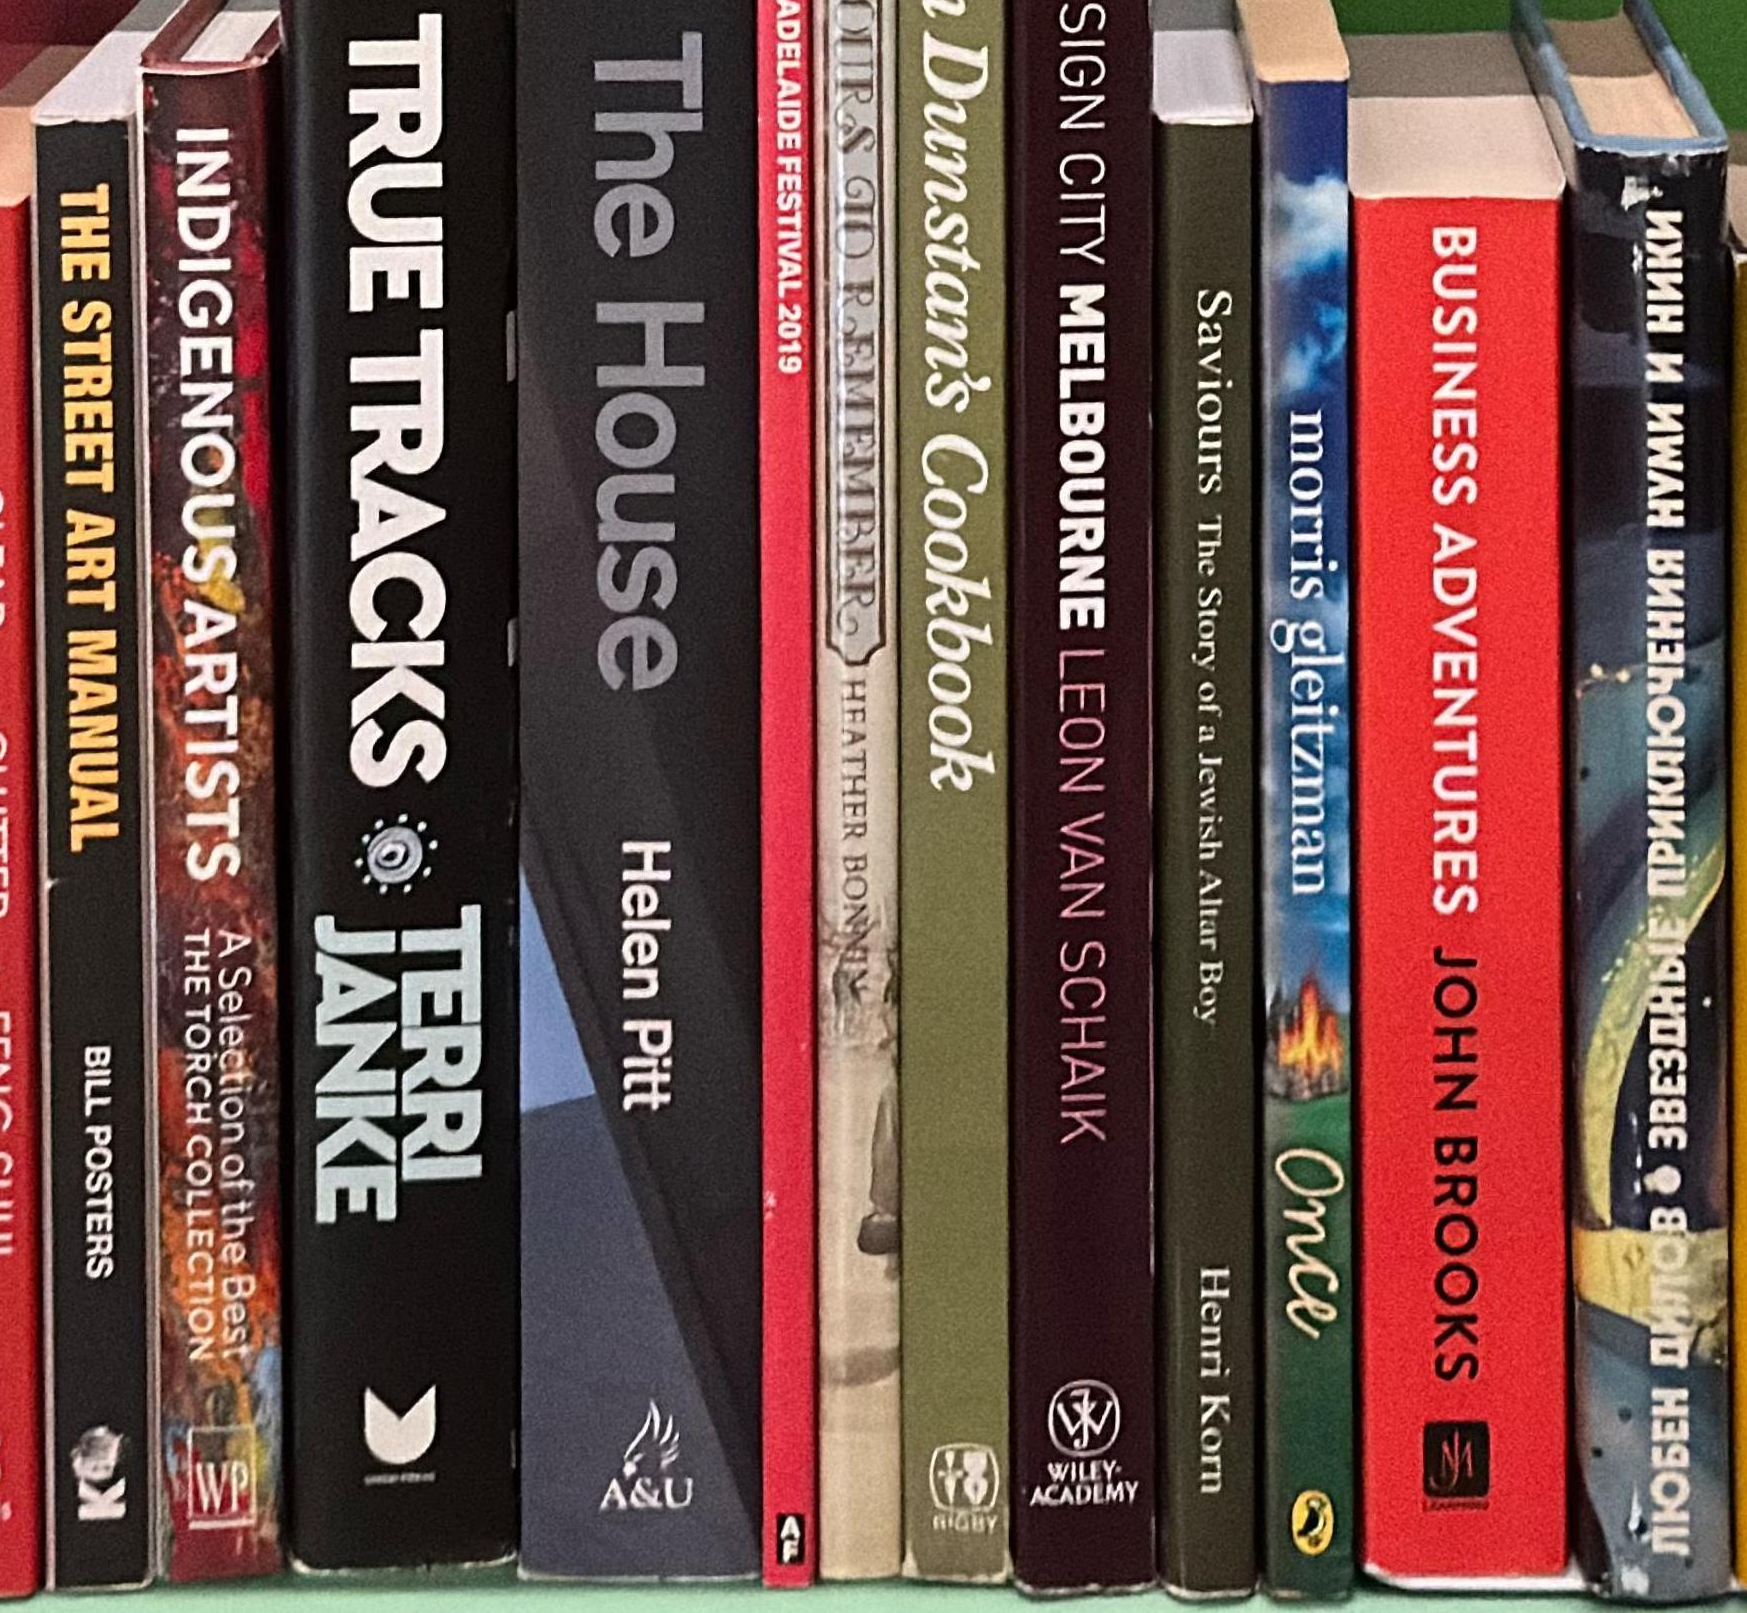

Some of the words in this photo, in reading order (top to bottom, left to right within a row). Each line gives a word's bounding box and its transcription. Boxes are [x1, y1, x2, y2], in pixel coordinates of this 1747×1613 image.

[347, 12, 444, 312] TRUE
[593, 31, 704, 258] The
[1059, 153, 1106, 266] CITY
[60, 183, 110, 282] THE
[777, 158, 802, 297] FESTIVAL
[922, 31, 992, 414] Dunstan's
[1646, 209, 1684, 333] НИКИ
[62, 300, 115, 494] STREET
[176, 127, 237, 584] INDIGENOUS
[778, 305, 803, 375] 2019
[1196, 288, 1234, 496] Saviours
[1431, 225, 1479, 507] BUSINESS
[1646, 353, 1684, 383] И
[594, 301, 706, 691] House
[836, 278, 877, 637] REMEMBER
[1059, 284, 1106, 631] MELBOURNE
[1289, 409, 1340, 600] morris
[1646, 402, 1686, 528] НУМИ
[66, 509, 117, 612] ART
[348, 328, 447, 787] TRACKS
[921, 433, 996, 792] Cookbook
[1197, 514, 1224, 578] The
[1191, 586, 1224, 673] Story
[1197, 683, 1223, 718] of
[68, 630, 120, 853] MANUAL
[183, 599, 241, 882] ARTISTS
[841, 679, 868, 841] HEATHER
[1059, 648, 1106, 794] LEON
[1198, 725, 1216, 744] a
[1269, 619, 1346, 896] gleitzman
[1432, 522, 1479, 916] ADVENTURES
[1647, 548, 1687, 897] ПРИКЛЮЧЕНИЯ
[1059, 810, 1106, 920] VAN
[1197, 752, 1225, 861] Jewish
[184, 927, 212, 996] THE
[218, 928, 251, 958] A
[621, 841, 673, 1000] Helen
[1198, 870, 1224, 951] Altar
[185, 1002, 213, 1124] TORCH
[218, 966, 251, 1144] Selection
[314, 914, 397, 1225] JANKE
[399, 904, 484, 1182] TERRI
[622, 1019, 673, 1112] Pitt
[1059, 940, 1108, 1145] SCHAIK
[1192, 961, 1225, 1025] Boy
[1432, 945, 1479, 1111] JOHN
[1648, 916, 1688, 1150] ЗВЕЗДНЫЕ
[85, 1044, 112, 1116] BILL
[86, 1125, 113, 1280] POSTERS
[187, 1132, 215, 1362] COLLECTION
[219, 1153, 254, 1194] of
[221, 1200, 255, 1264] the
[1274, 1147, 1345, 1340] Once
[222, 1274, 256, 1359] Best
[1200, 1267, 1231, 1380] Henri
[1434, 1136, 1480, 1383] BROOKS
[1650, 1206, 1690, 1371] ДИЛОВ
[195, 1459, 250, 1512] WP
[599, 1477, 694, 1512] A&U
[1029, 1480, 1140, 1508] ACADEMY
[1200, 1393, 1231, 1495] Korn
[1651, 1387, 1691, 1558] ЛЮБЕН
[931, 1513, 998, 1535] RIGBY
